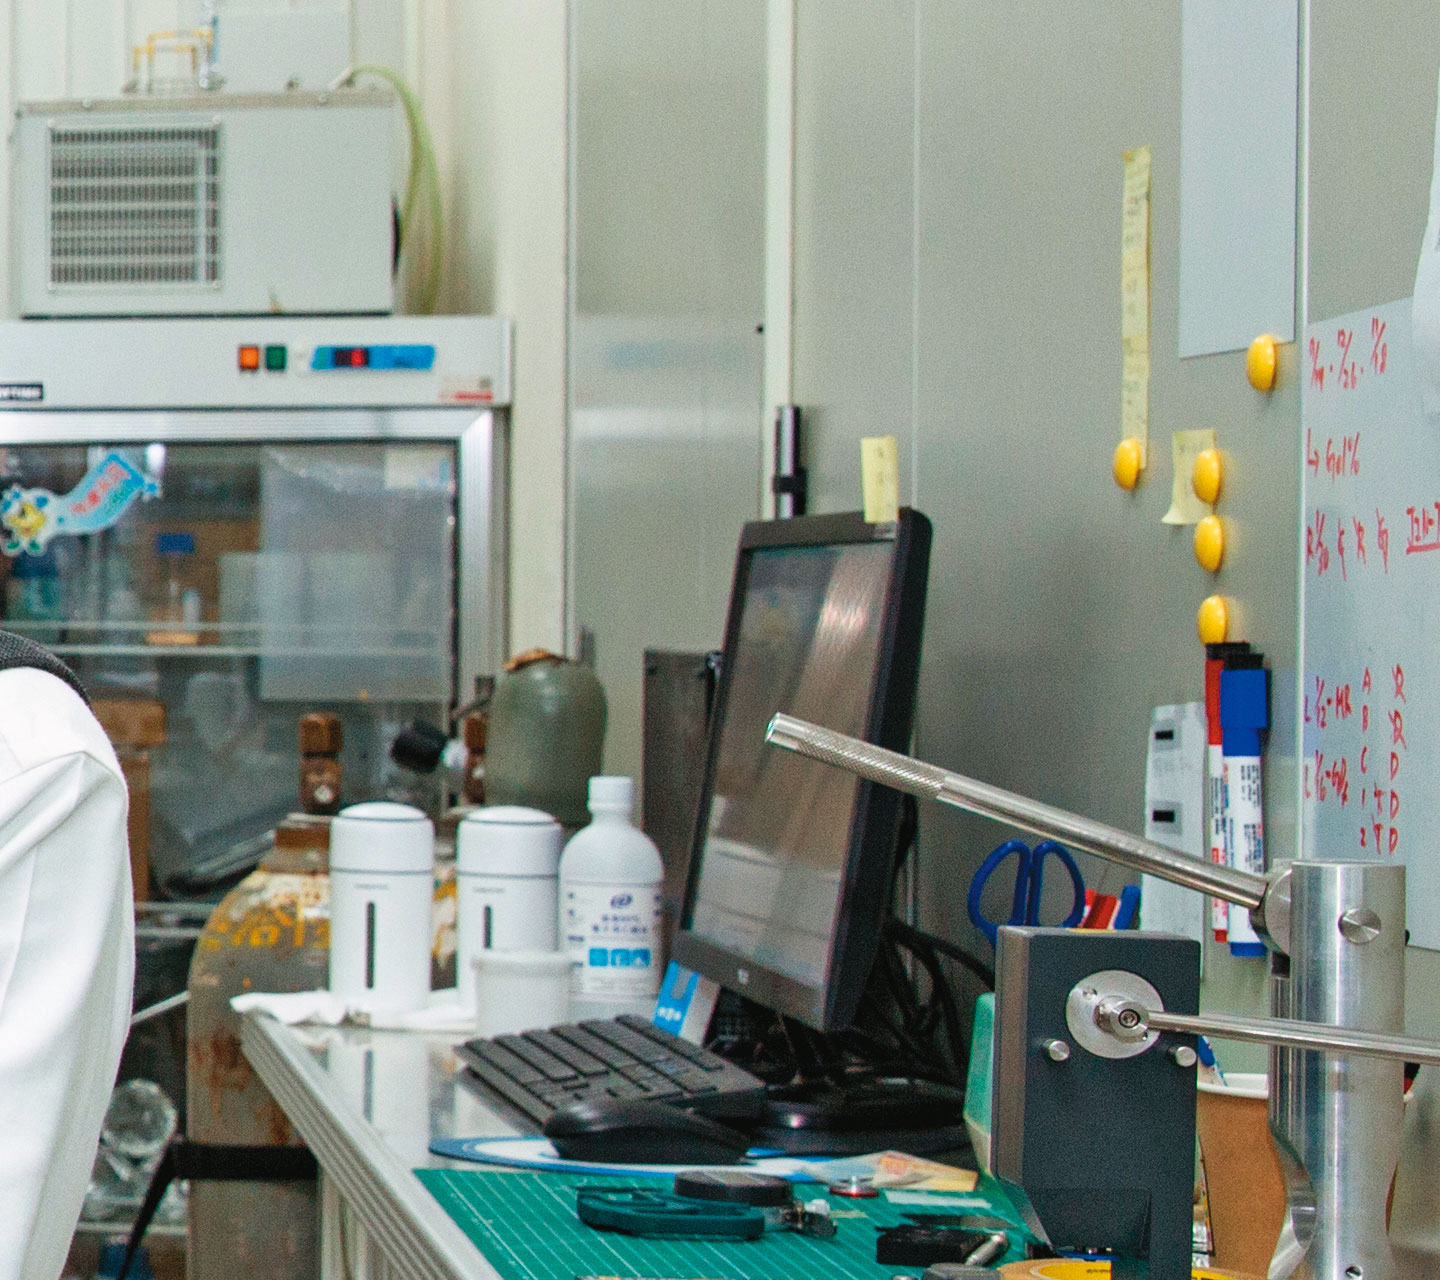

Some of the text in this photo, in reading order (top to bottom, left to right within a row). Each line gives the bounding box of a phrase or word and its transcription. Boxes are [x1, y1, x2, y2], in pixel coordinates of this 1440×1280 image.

[1390, 750, 1400, 781] D
[1389, 788, 1400, 821] D
[1389, 826, 1399, 856] D
